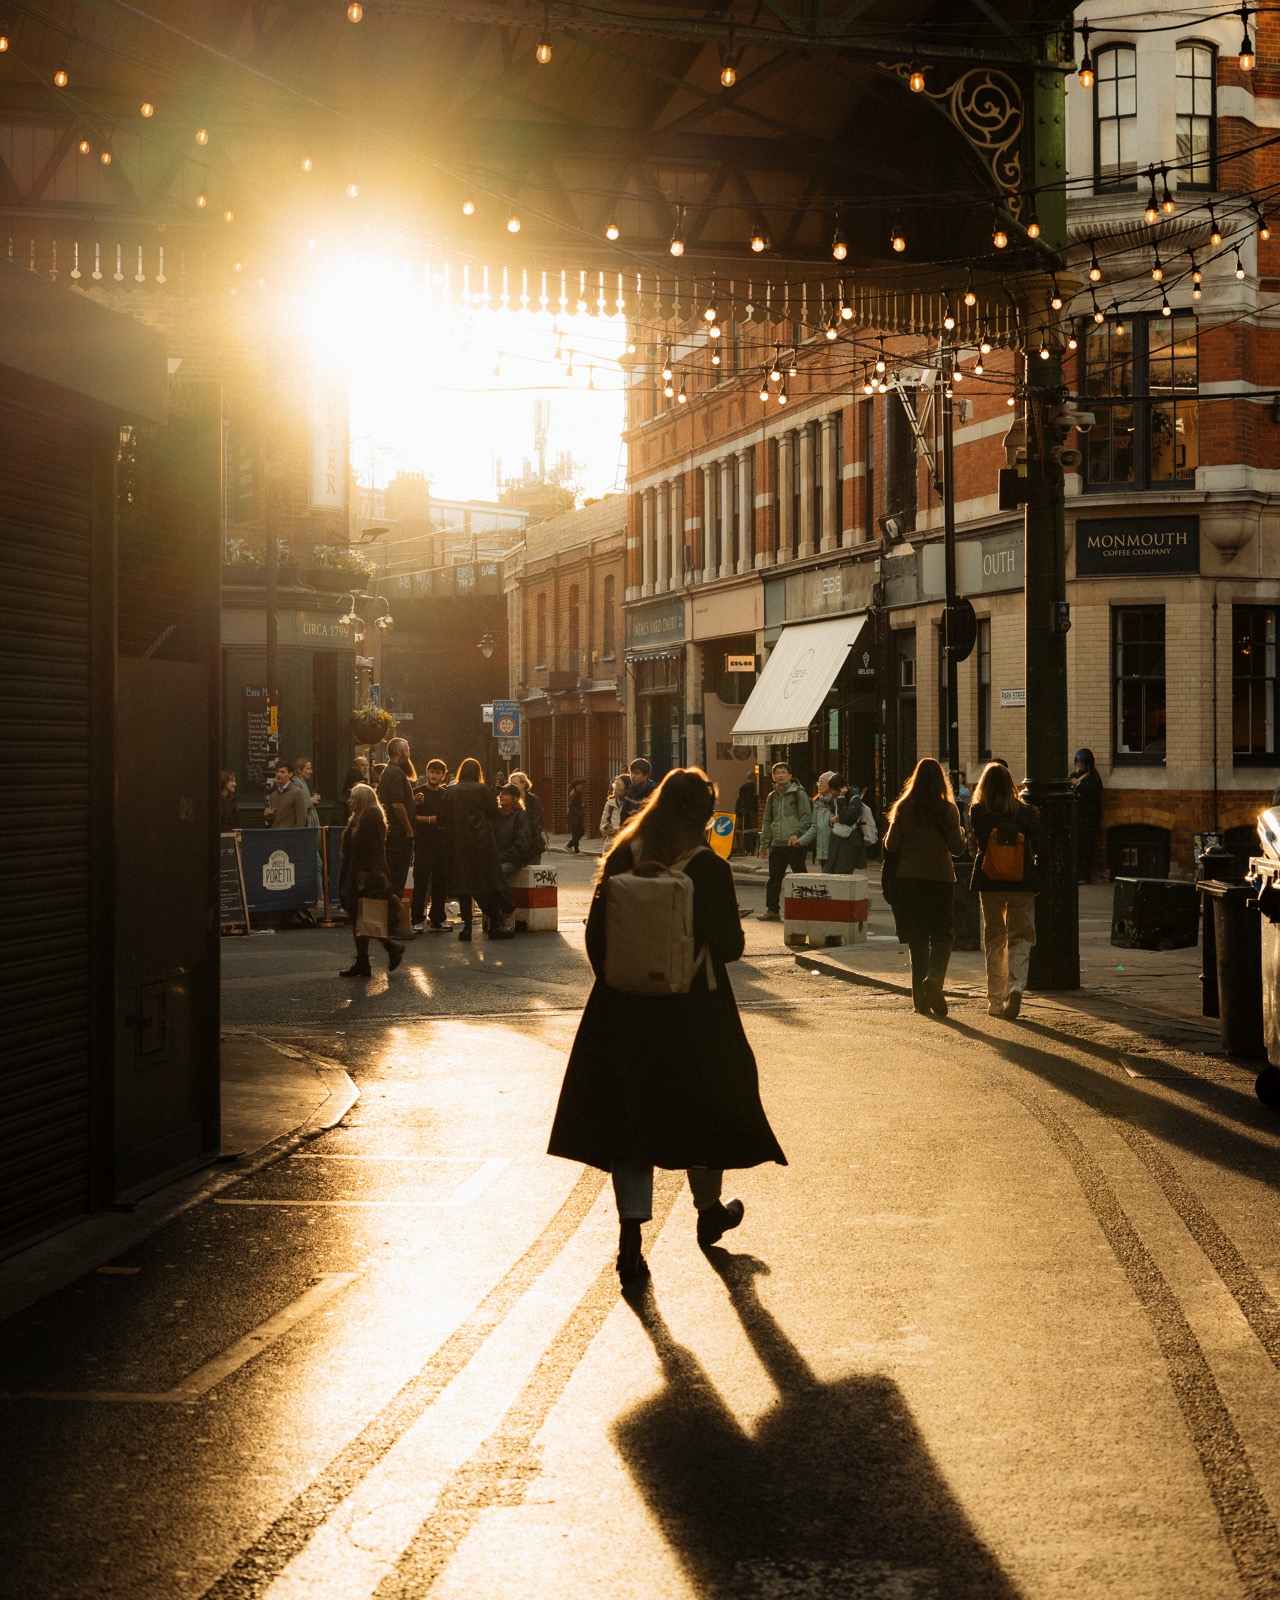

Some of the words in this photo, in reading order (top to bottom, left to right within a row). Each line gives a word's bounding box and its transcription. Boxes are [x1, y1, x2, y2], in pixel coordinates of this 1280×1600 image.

[1087, 532, 1188, 548] MONMOUTH
[1103, 549, 1131, 557] COFFEE
[1132, 548, 1172, 556] COMPANY
[983, 550, 1016, 576] OUTH
[303, 622, 328, 636] CIRCA
[662, 615, 679, 632] DAIRY
[1001, 691, 1013, 700] PARK
[265, 868, 292, 884] PORETTI
